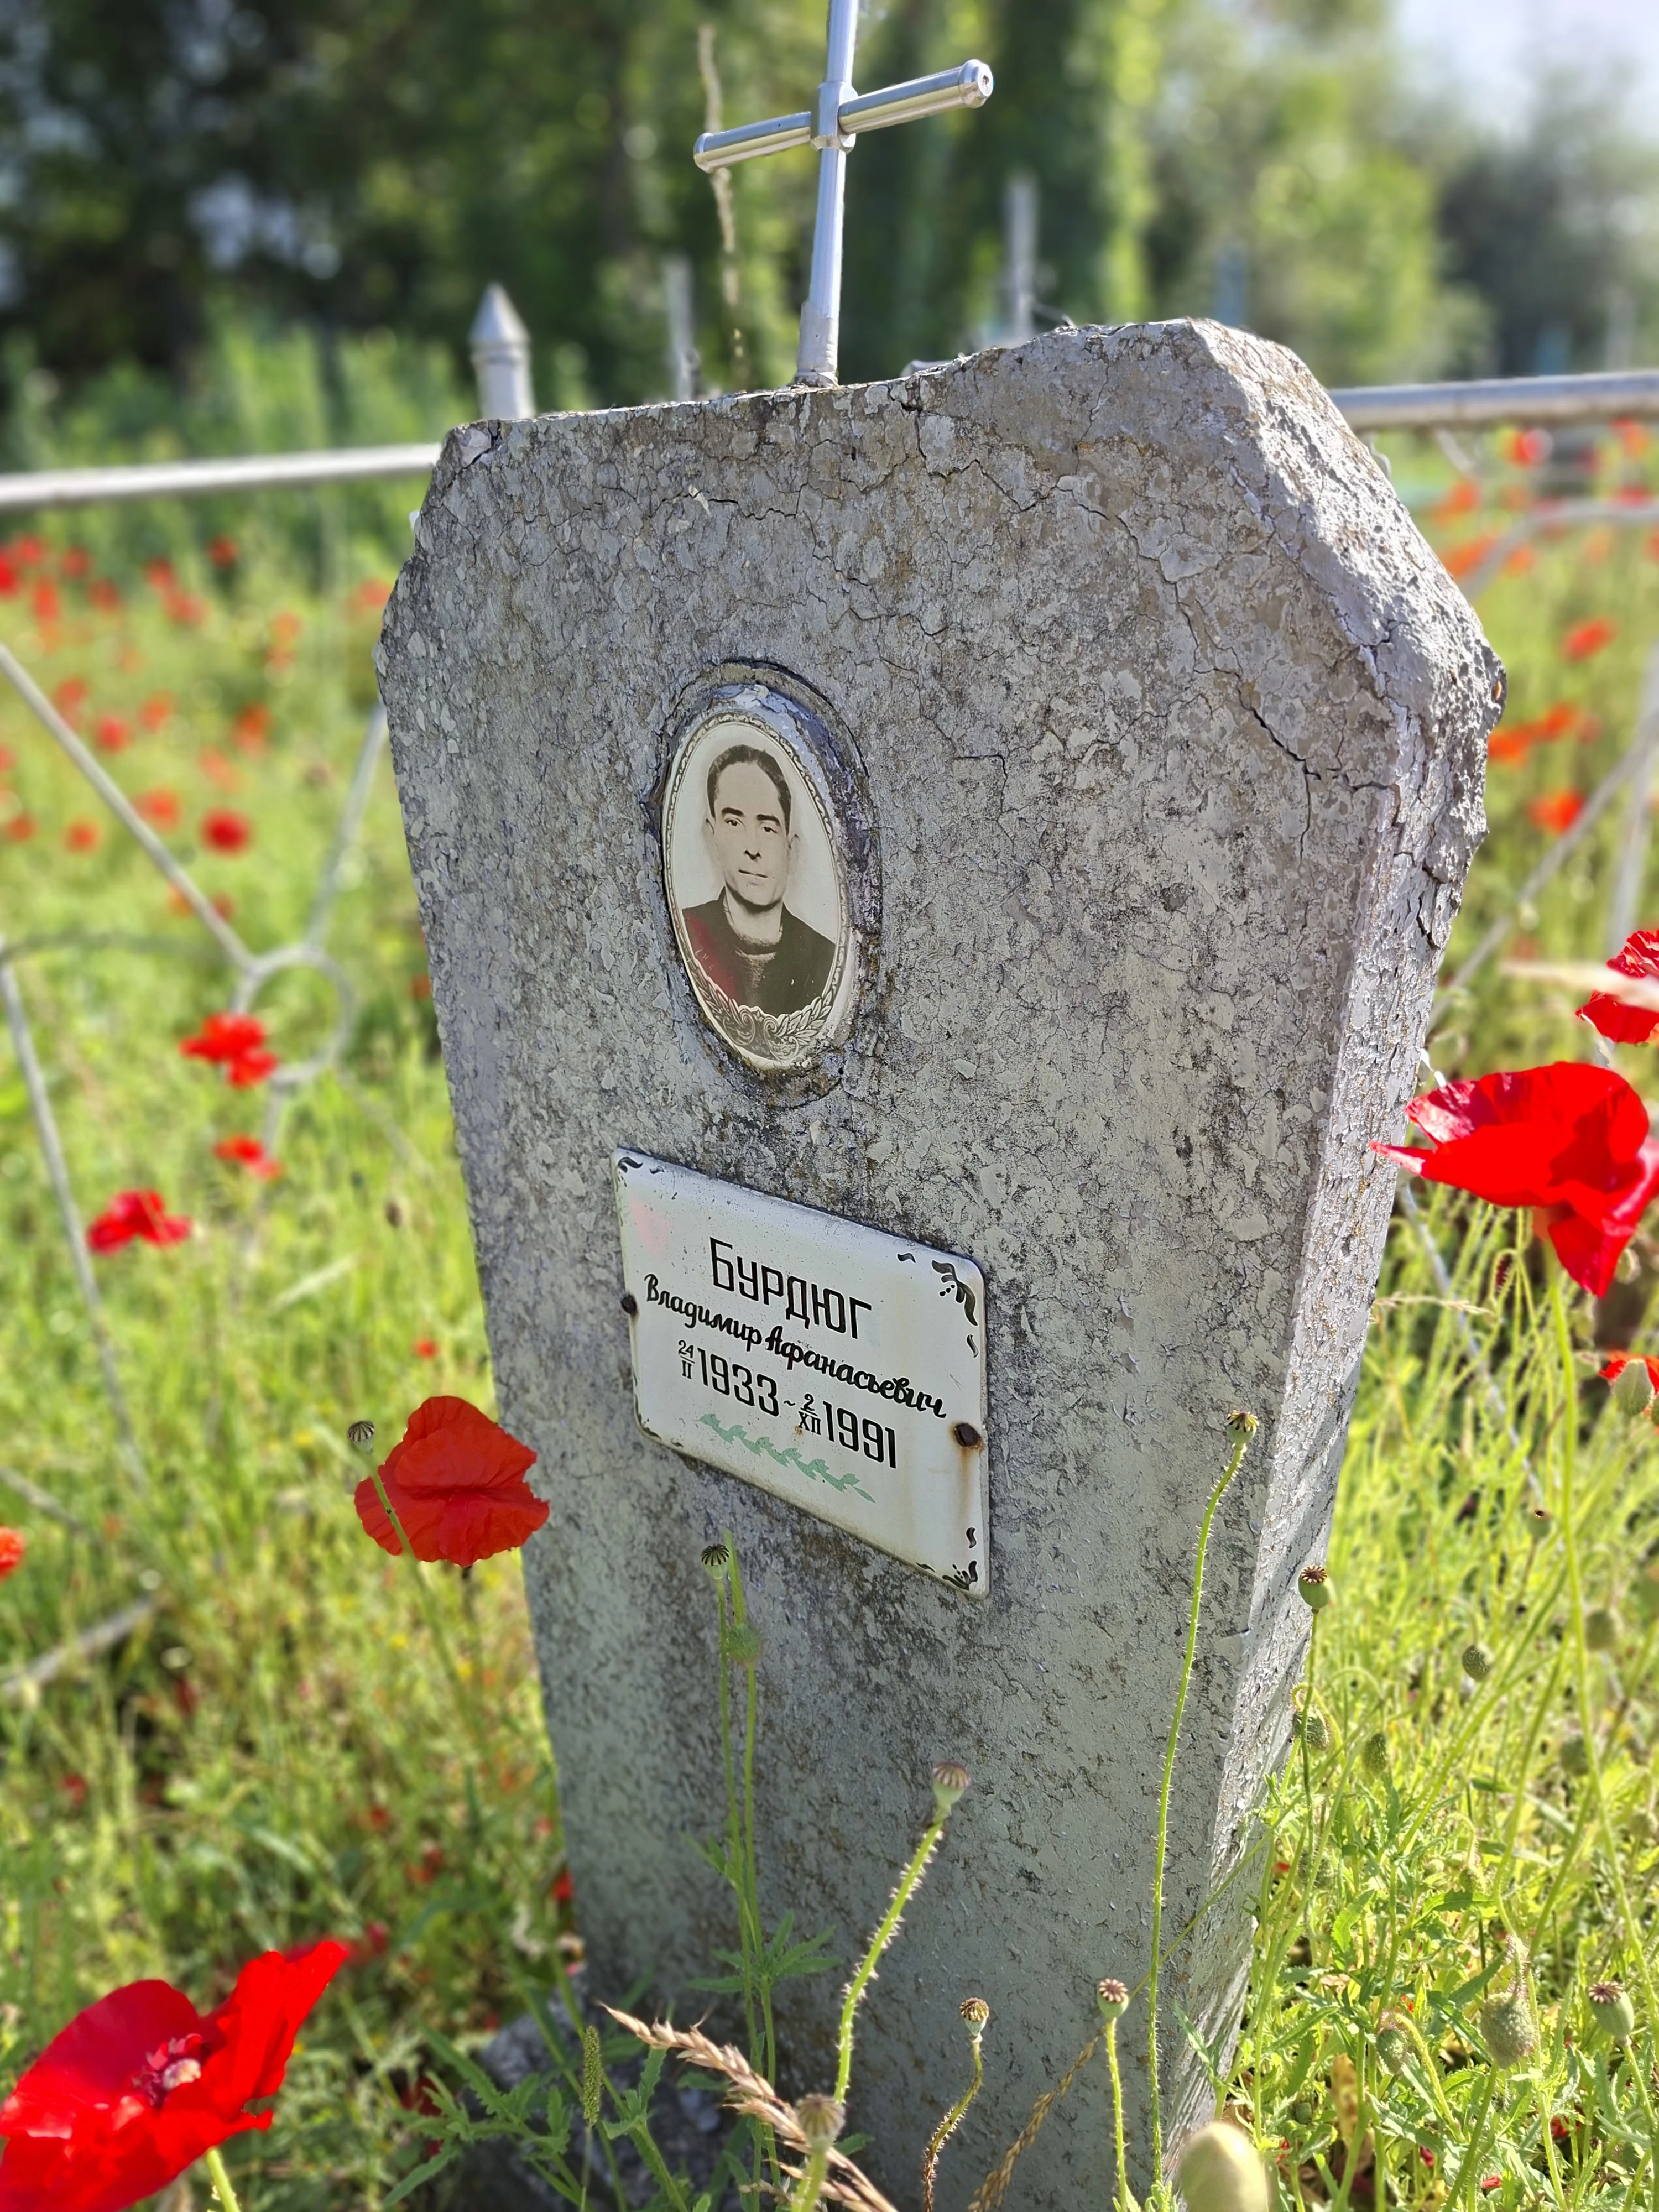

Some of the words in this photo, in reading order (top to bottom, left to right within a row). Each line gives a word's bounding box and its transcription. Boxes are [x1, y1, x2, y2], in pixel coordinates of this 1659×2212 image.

[710, 1237, 872, 1339] БУРДЮГ
[644, 1274, 763, 1352] Владимир
[765, 1326, 947, 1418] Афанасьевич
[678, 1340, 694, 1358] 24
[697, 1347, 779, 1417] 1933
[803, 1393, 815, 1411] 2
[822, 1401, 896, 1469] 1991
